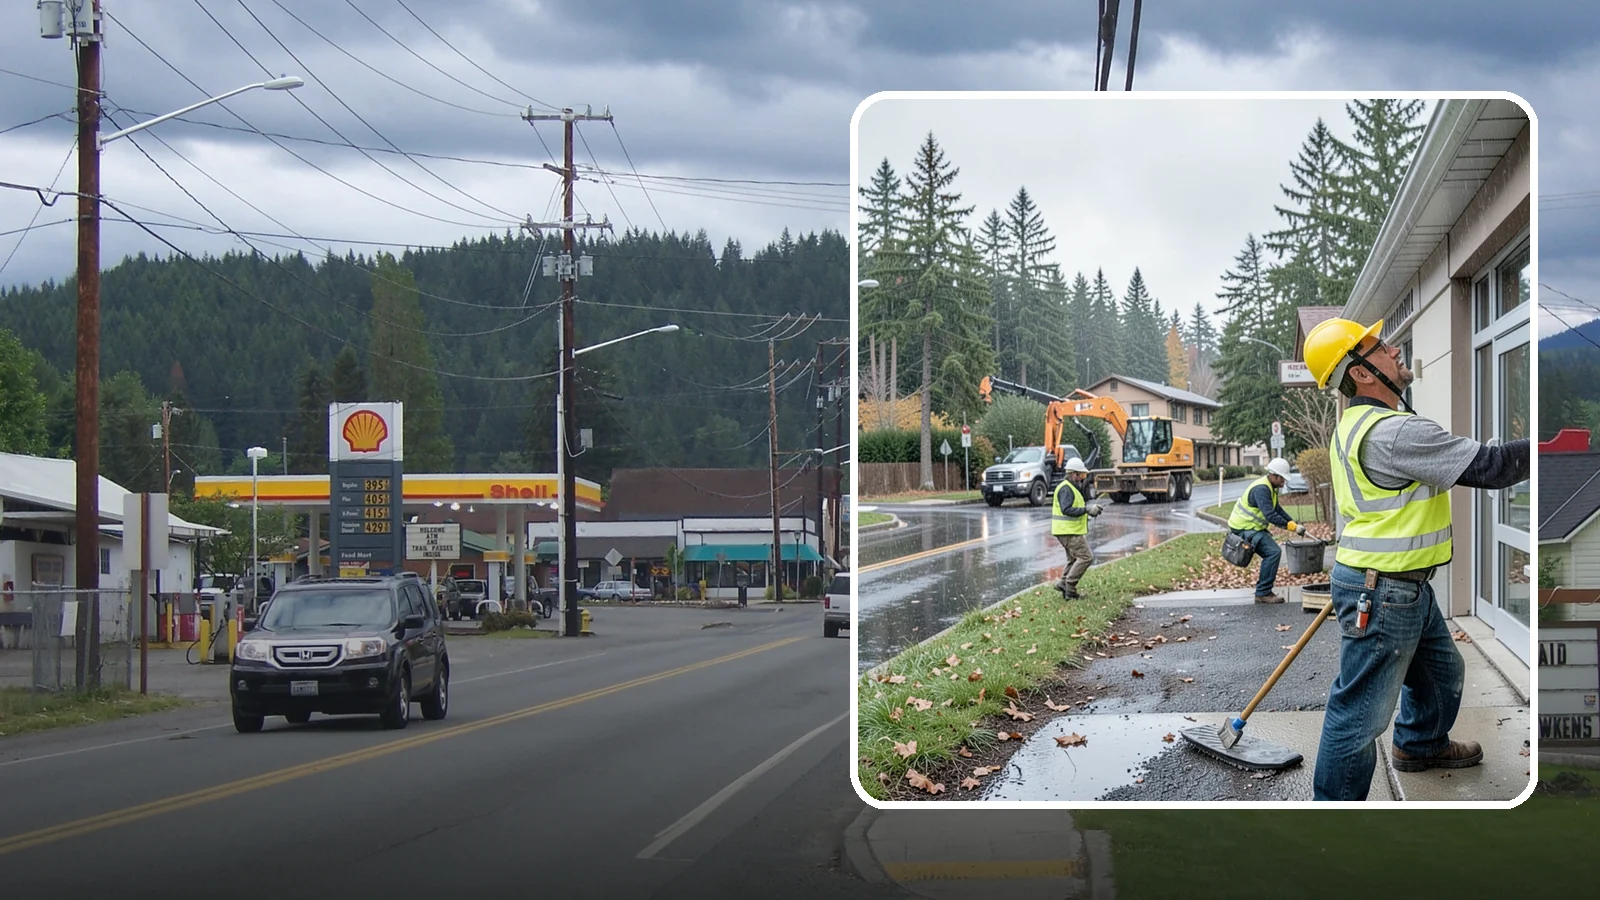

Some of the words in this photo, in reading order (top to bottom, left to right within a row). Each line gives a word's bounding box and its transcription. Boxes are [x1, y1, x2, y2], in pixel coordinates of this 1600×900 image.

[366, 480, 383, 490] 395
[490, 484, 547, 499] Shell
[366, 494, 383, 504] 405
[366, 508, 383, 518] 415
[366, 522, 383, 533] 429
